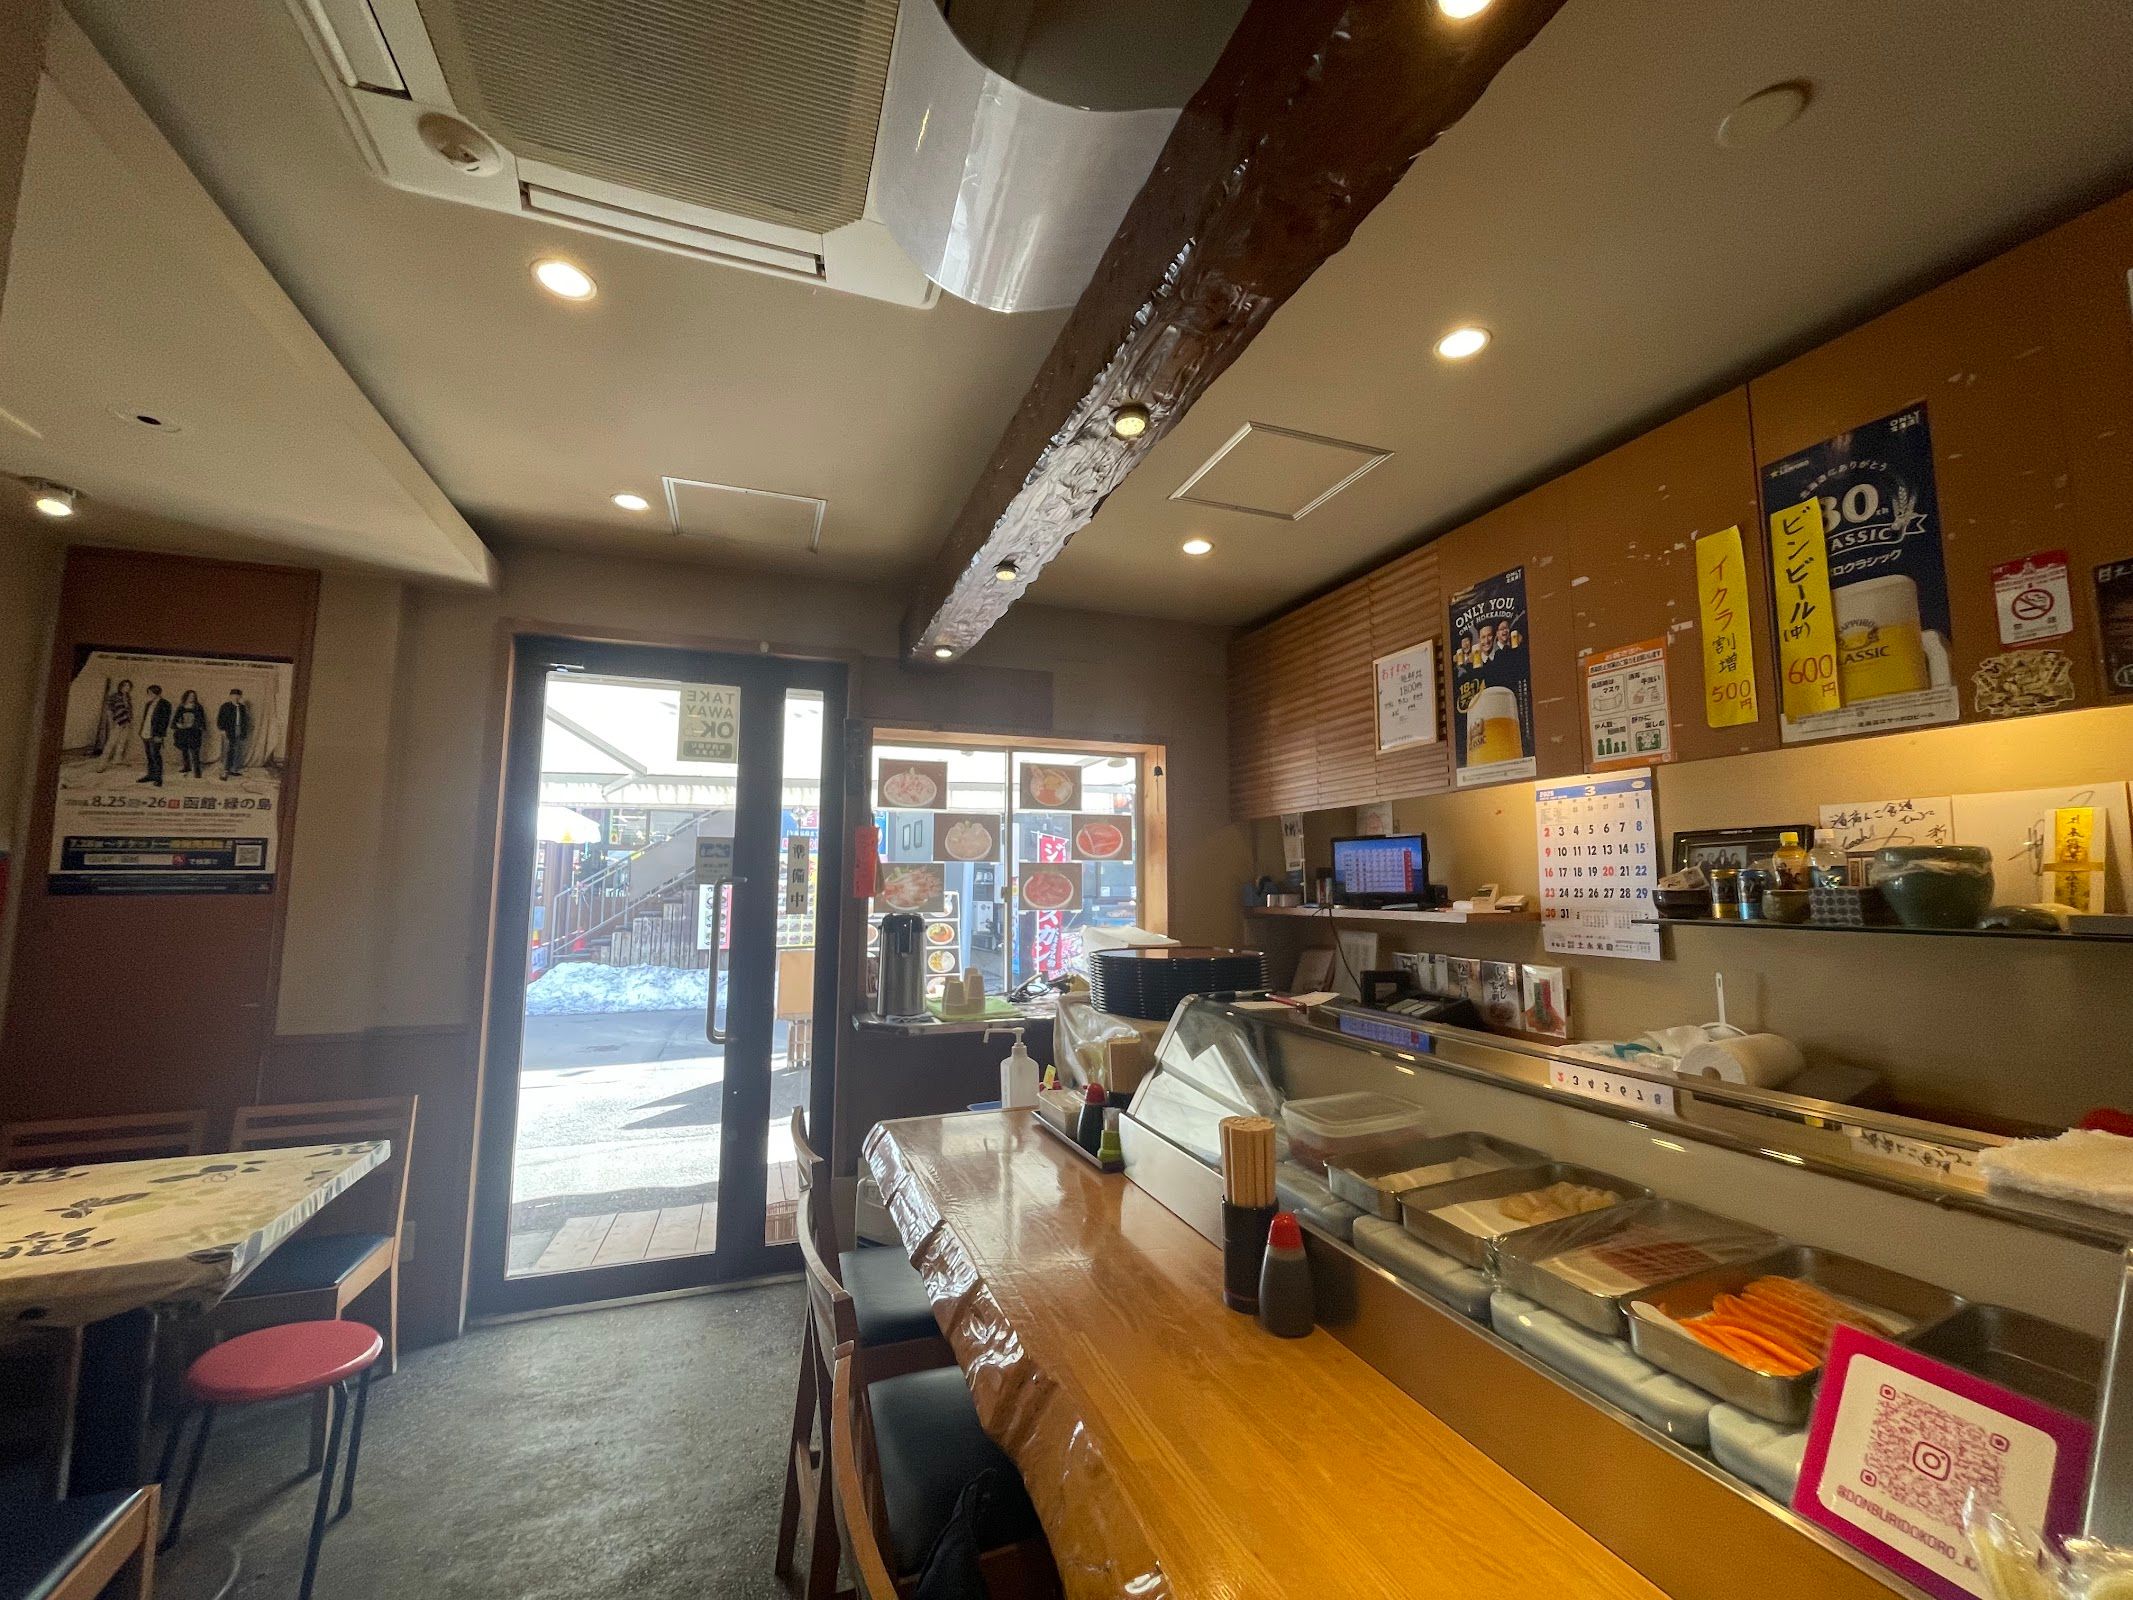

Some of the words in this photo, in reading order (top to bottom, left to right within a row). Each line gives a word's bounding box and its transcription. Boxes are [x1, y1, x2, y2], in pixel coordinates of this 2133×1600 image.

[1832, 528, 1893, 551] ASSIC
[1832, 549, 1902, 576] ロクラシック
[1456, 602, 1484, 628] ONLY
[1489, 598, 1514, 610] YOU,
[1459, 620, 1474, 636] ONLY
[1603, 686, 1620, 694] マスク
[1584, 786, 1596, 796] 3
[1544, 828, 1550, 837] 2
[1559, 826, 1564, 836] 3
[1573, 826, 1579, 836] 4
[1589, 825, 1594, 834] 5
[1604, 824, 1609, 833] 6
[1620, 822, 1625, 832] 7
[1636, 821, 1642, 831] 8
[1545, 848, 1551, 858] 9
[1558, 847, 1567, 857] 10
[1574, 846, 1581, 856] 11
[1588, 846, 1597, 856] 12
[1603, 845, 1612, 855] 13
[1619, 844, 1628, 854] 14
[1635, 843, 1645, 853] 15
[1545, 868, 1553, 877] 16
[1559, 868, 1567, 877] 17
[1574, 867, 1582, 876] 18
[1588, 867, 1597, 876] 19
[1603, 866, 1614, 876] 20
[1620, 866, 1629, 876] 21
[1635, 866, 1647, 876] 22
[1545, 888, 1555, 898] 23
[1560, 888, 1569, 898] 24
[1574, 888, 1584, 898] 25
[1588, 888, 1598, 898] 26
[1604, 888, 1614, 898] 27
[1620, 888, 1631, 898] 28
[1636, 888, 1648, 898] 29
[1545, 909, 1556, 918] 30
[1560, 909, 1569, 918] 31
